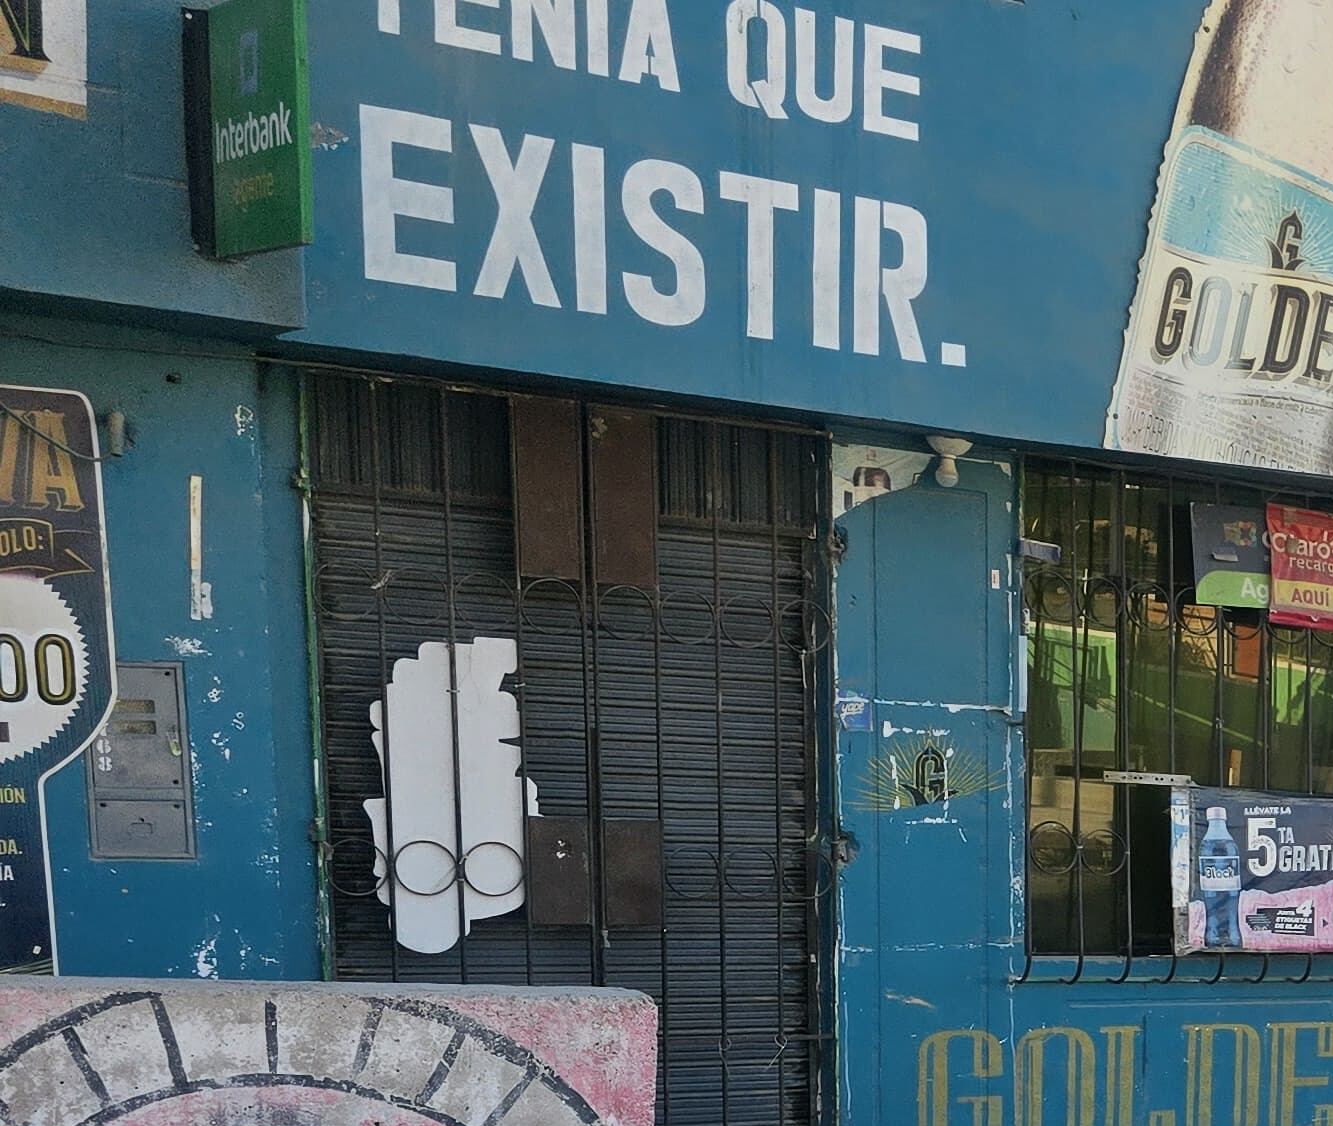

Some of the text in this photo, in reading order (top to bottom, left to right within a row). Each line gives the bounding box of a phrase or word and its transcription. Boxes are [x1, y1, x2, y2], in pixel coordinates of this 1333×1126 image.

[726, 0, 922, 141] QUE
[216, 101, 292, 164] Interbank
[359, 103, 966, 367] EXISTIR.
[1272, 532, 1331, 559] Caro
[1291, 587, 1330, 607] AQUÍ
[840, 702, 865, 719] yape
[1243, 806, 1292, 816] LLÉVATE LA
[1295, 899, 1313, 918] 4
